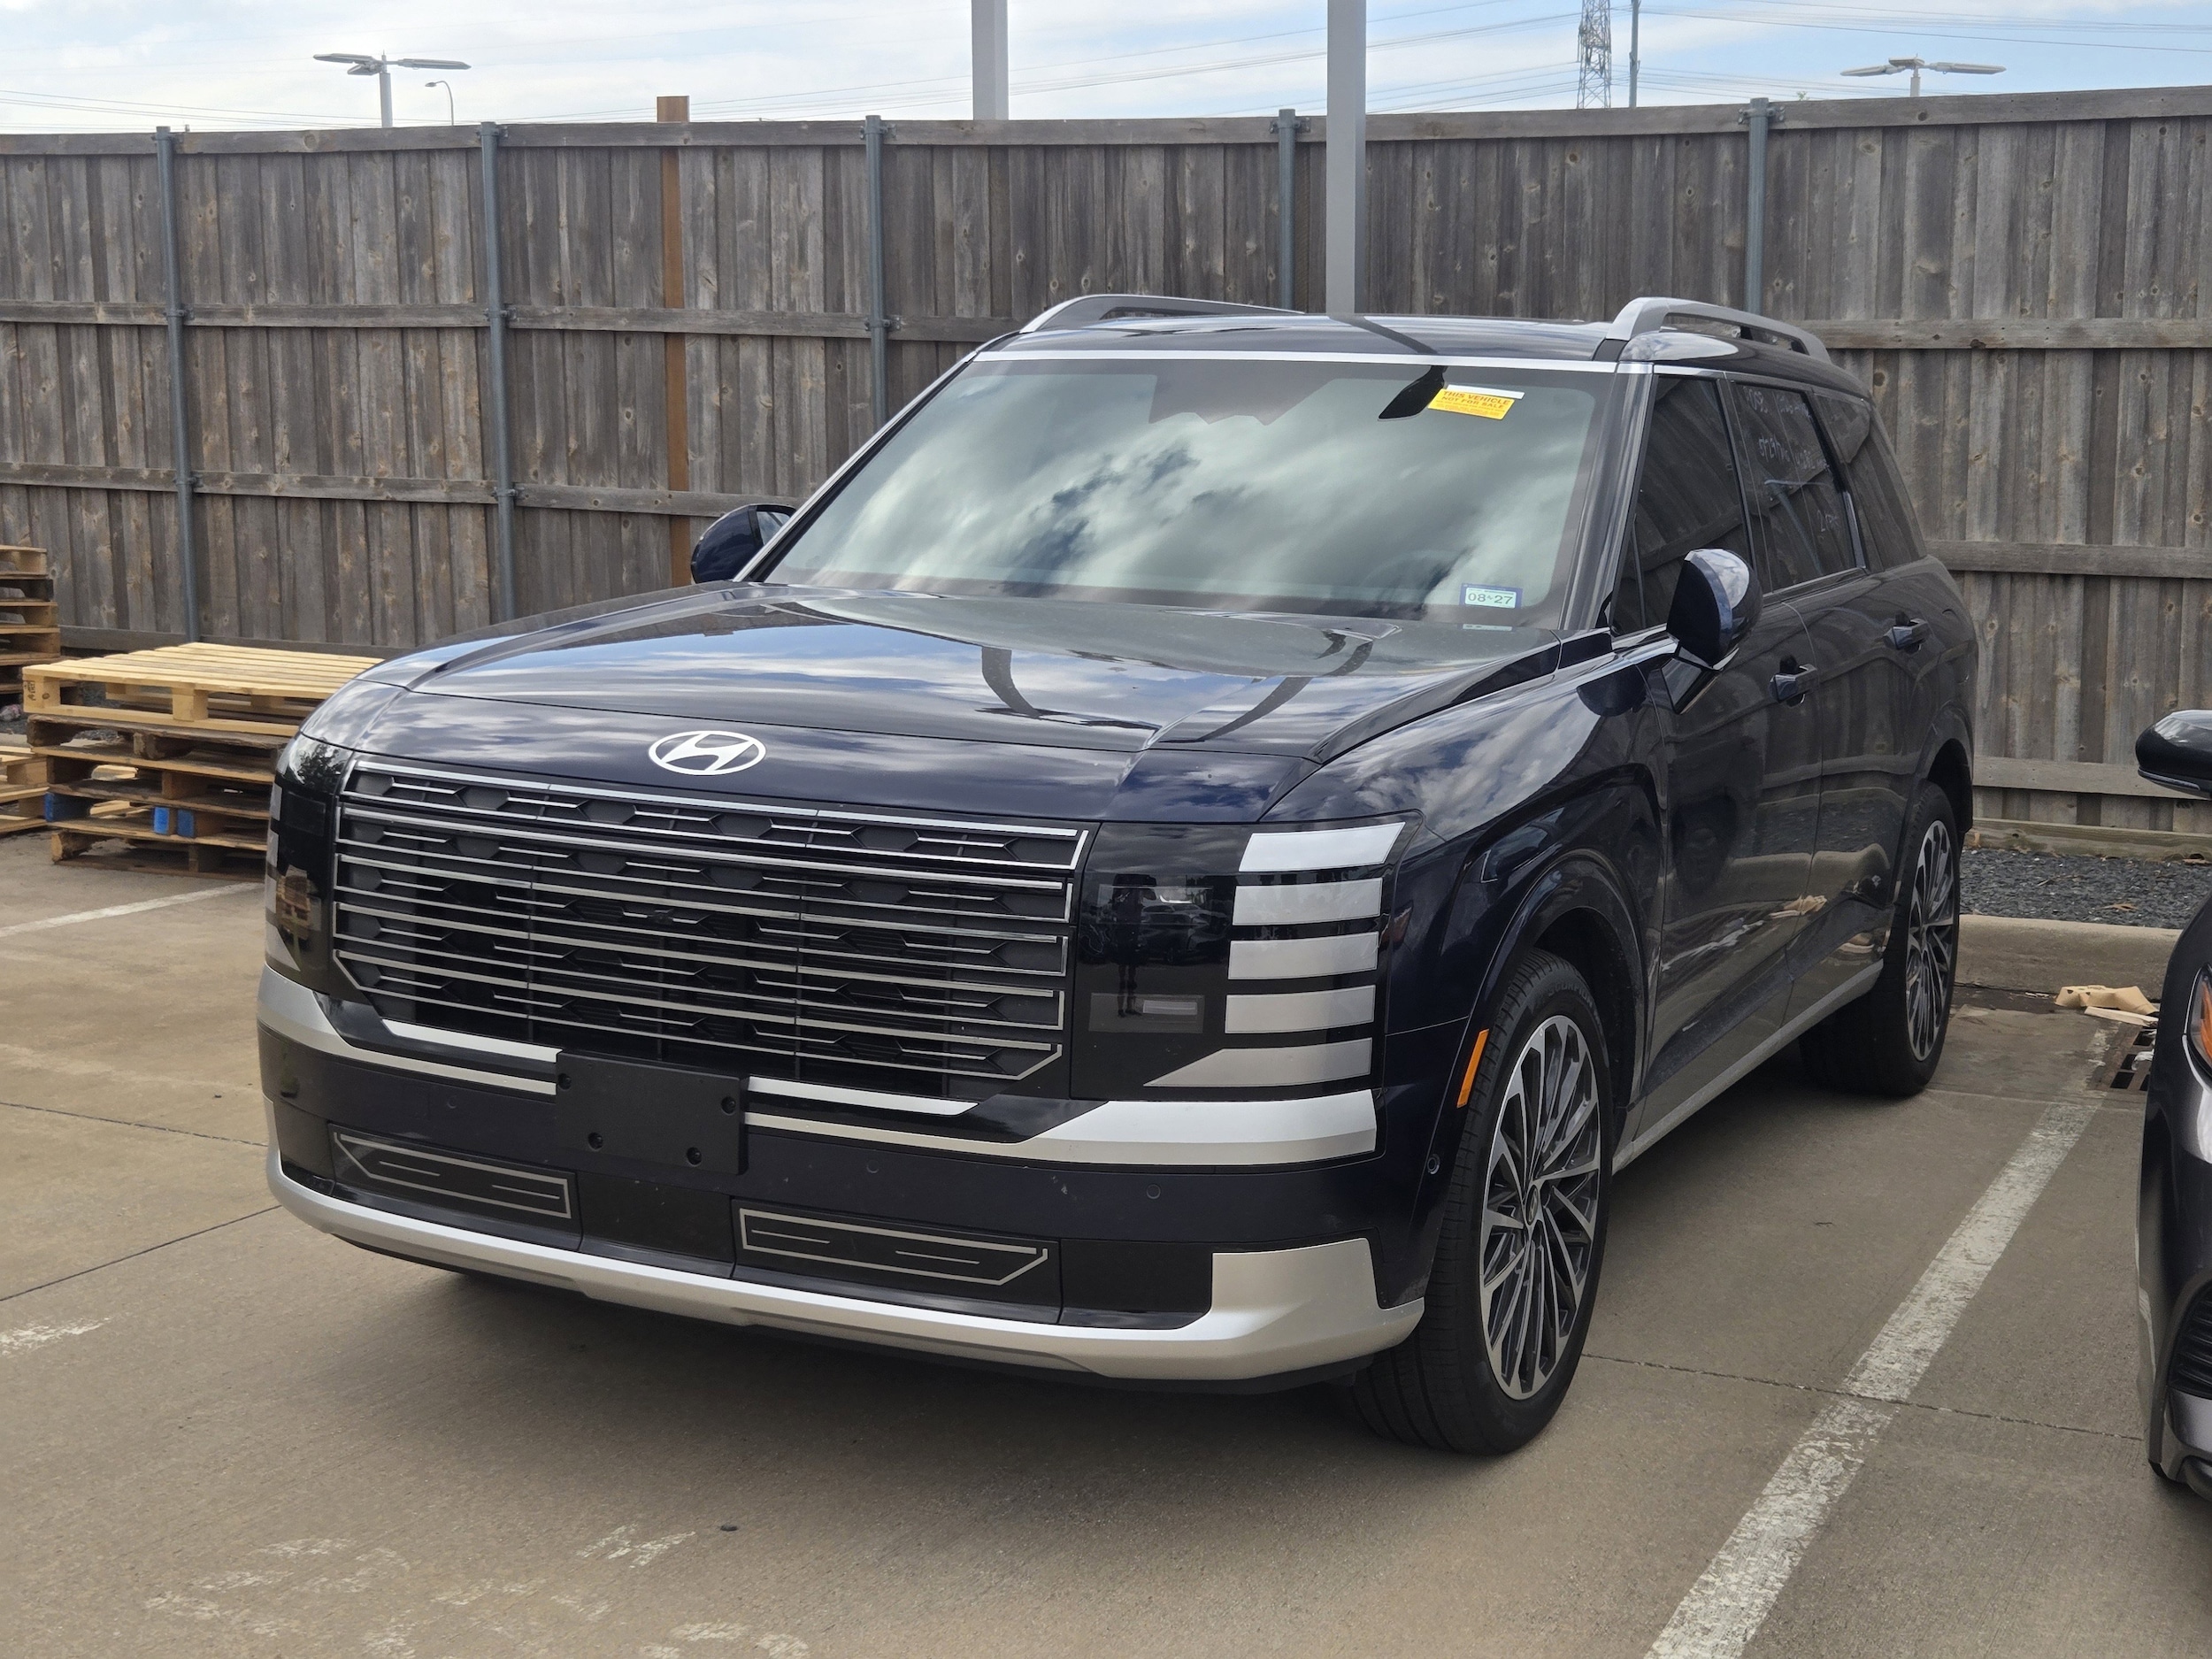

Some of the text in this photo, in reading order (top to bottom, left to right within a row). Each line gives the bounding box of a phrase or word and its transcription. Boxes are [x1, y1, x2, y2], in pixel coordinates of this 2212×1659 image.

[1468, 394, 1510, 404] VEHICLE
[1468, 593, 1513, 604] 08 27
